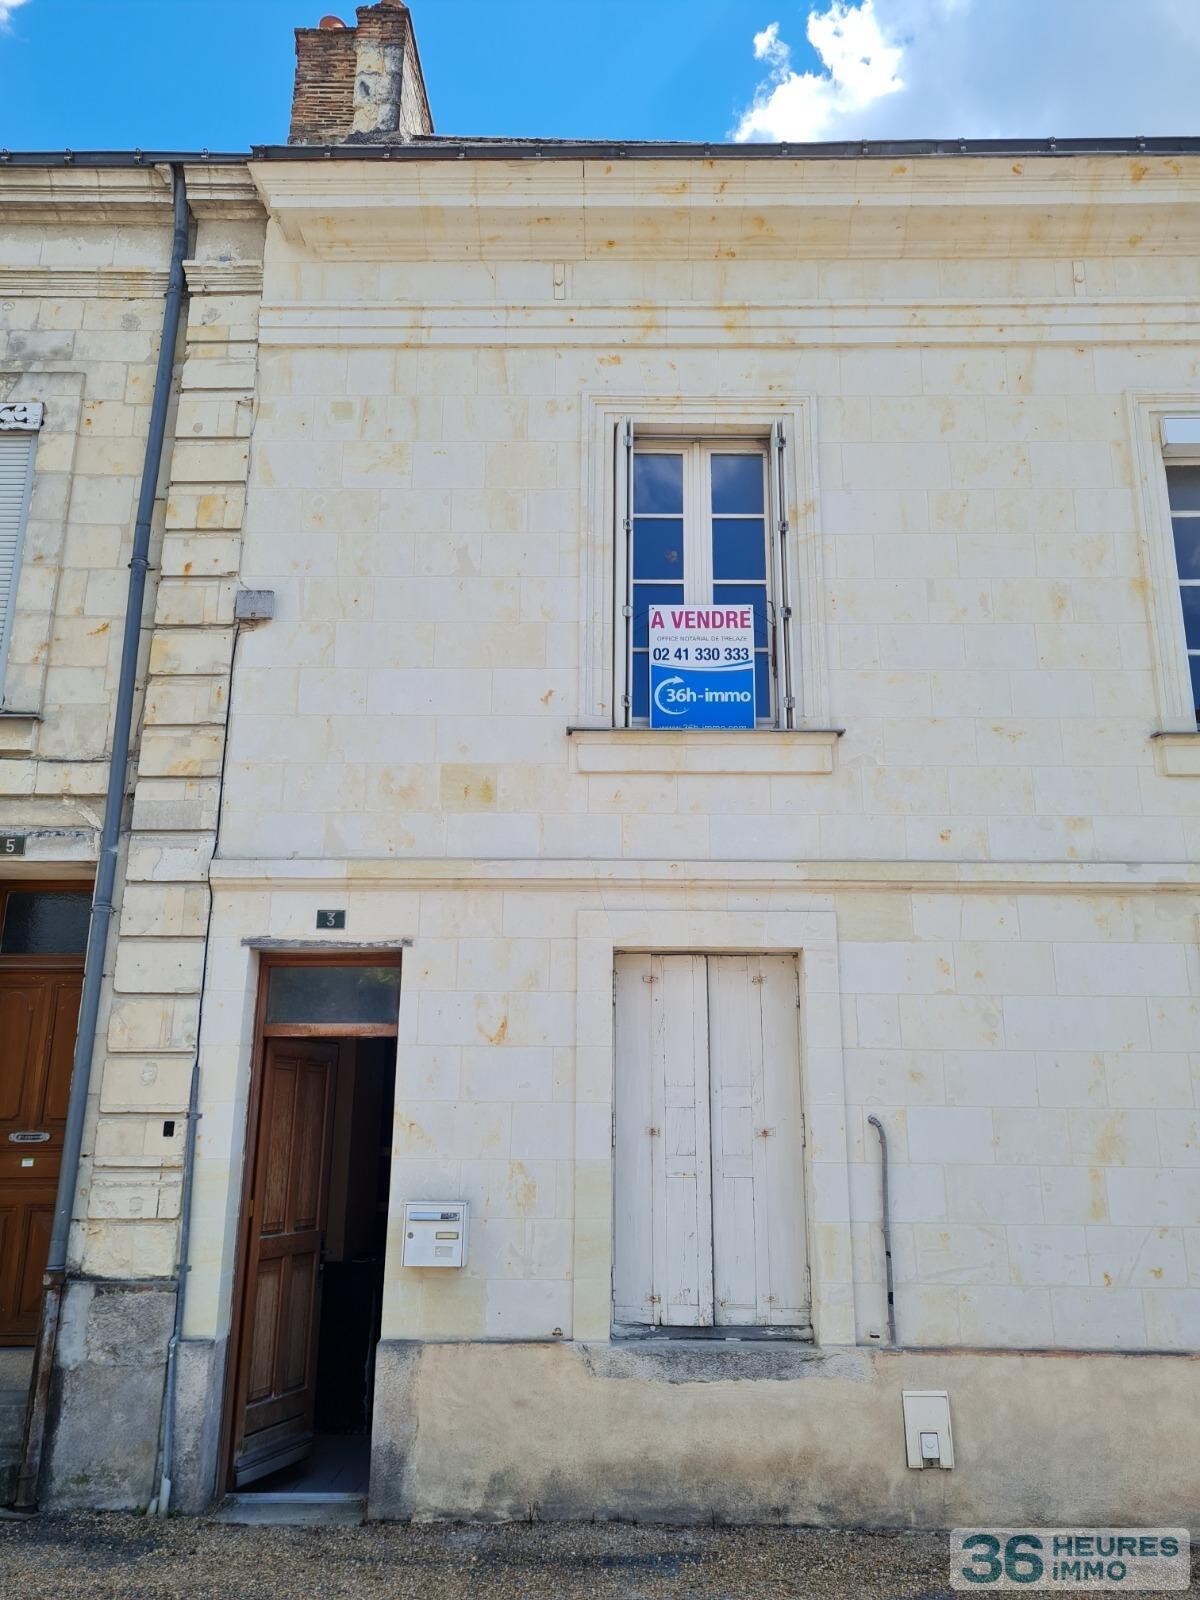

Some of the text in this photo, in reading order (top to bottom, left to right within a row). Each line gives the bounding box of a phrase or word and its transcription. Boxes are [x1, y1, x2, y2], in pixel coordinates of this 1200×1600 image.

[651, 610, 751, 628] A VENDRE
[653, 647, 749, 660] 02 41 330 333
[666, 687, 751, 702] 36h-immo
[6, 839, 15, 852] 5
[326, 912, 336, 926] 3
